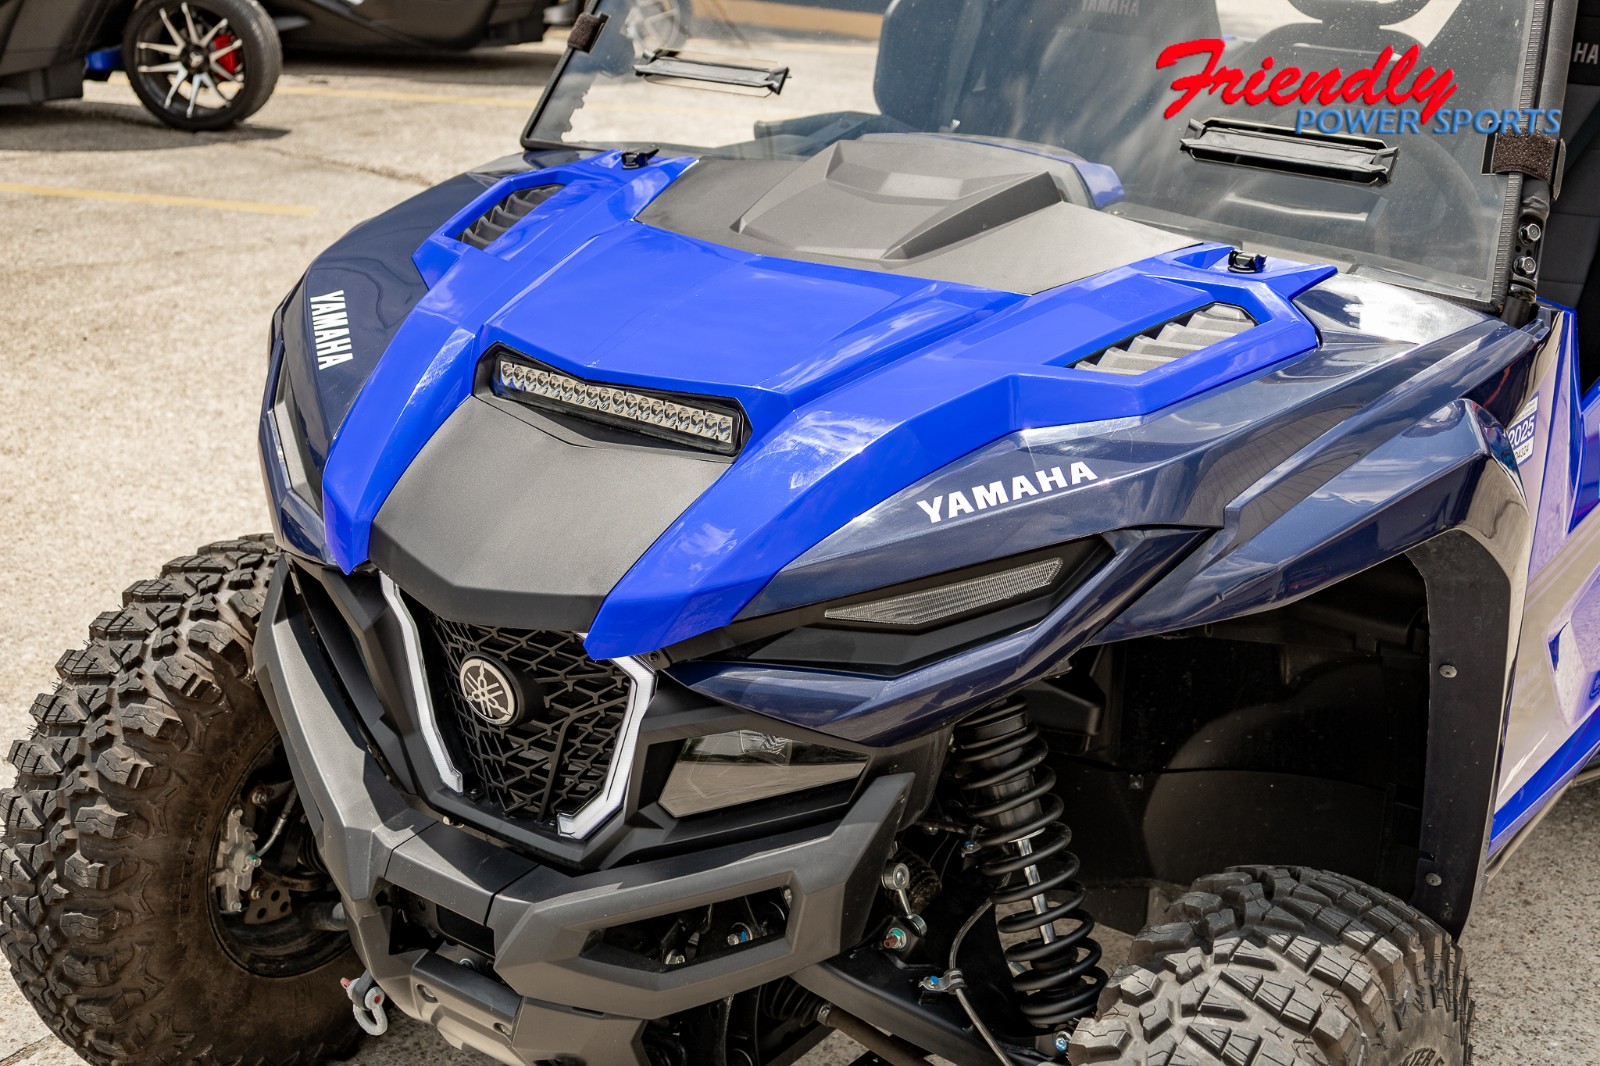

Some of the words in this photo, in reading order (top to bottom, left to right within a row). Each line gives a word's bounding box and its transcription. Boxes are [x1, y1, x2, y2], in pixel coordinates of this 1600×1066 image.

[310, 290, 353, 370] YAMAHA
[1507, 415, 1535, 448] 2025
[917, 461, 1098, 524] YAMAHA
